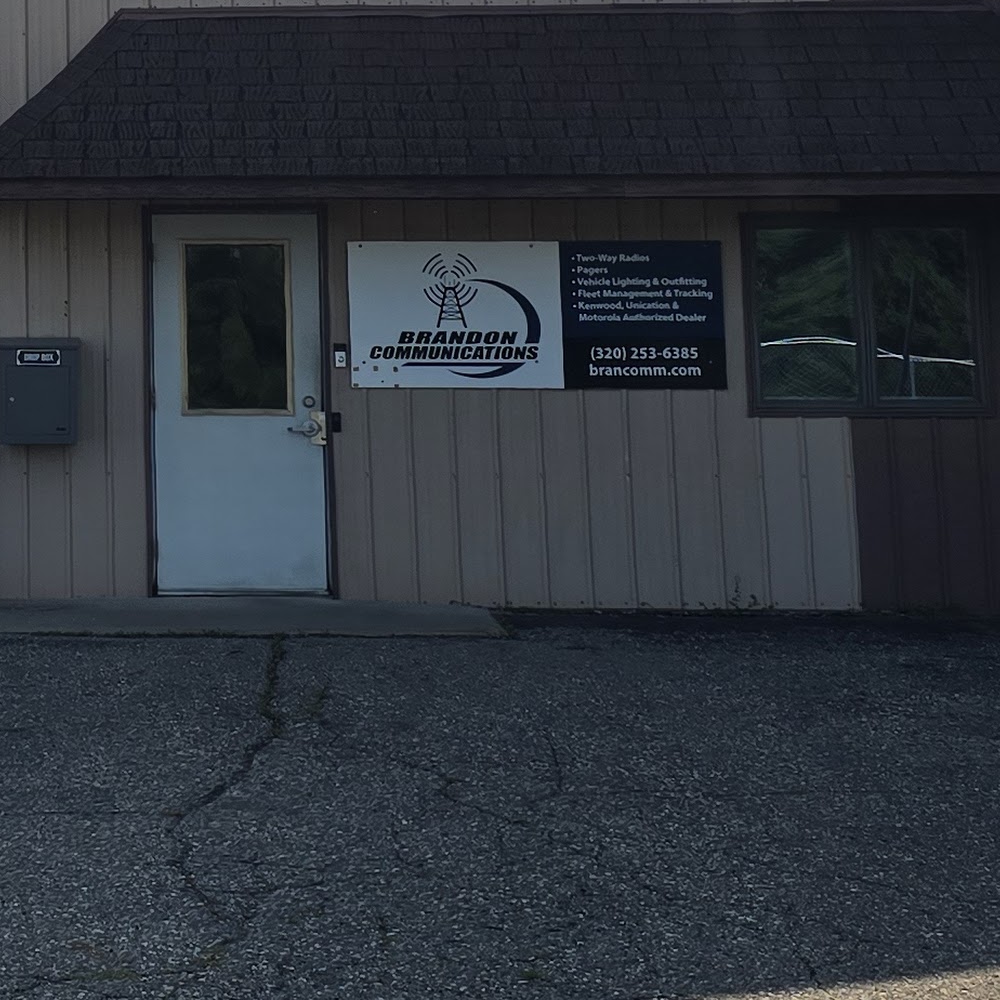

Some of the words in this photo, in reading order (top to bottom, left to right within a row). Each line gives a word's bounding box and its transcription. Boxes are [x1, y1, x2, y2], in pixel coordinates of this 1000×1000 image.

[576, 253, 617, 264] Two-Way
[619, 253, 650, 262] Radios
[576, 265, 608, 276] Pagers
[577, 277, 611, 286] Vehicle
[612, 277, 651, 287] Lighting
[652, 278, 660, 286] &
[661, 276, 708, 287] Outfitting
[578, 289, 601, 298] Fleet
[602, 289, 664, 299] Management
[665, 289, 673, 298] &
[674, 288, 714, 300] Tracking
[626, 301, 671, 310] Unication
[672, 301, 680, 310] &
[579, 313, 621, 322] Motorola
[622, 313, 674, 322] Authorized
[676, 313, 707, 322] Dealer
[398, 330, 518, 345] BRANDON
[369, 345, 539, 360] COMMUNICATIONS
[590, 346, 627, 361] (320)
[630, 346, 699, 360] 253-6385
[588, 363, 702, 377] brancomm.com
